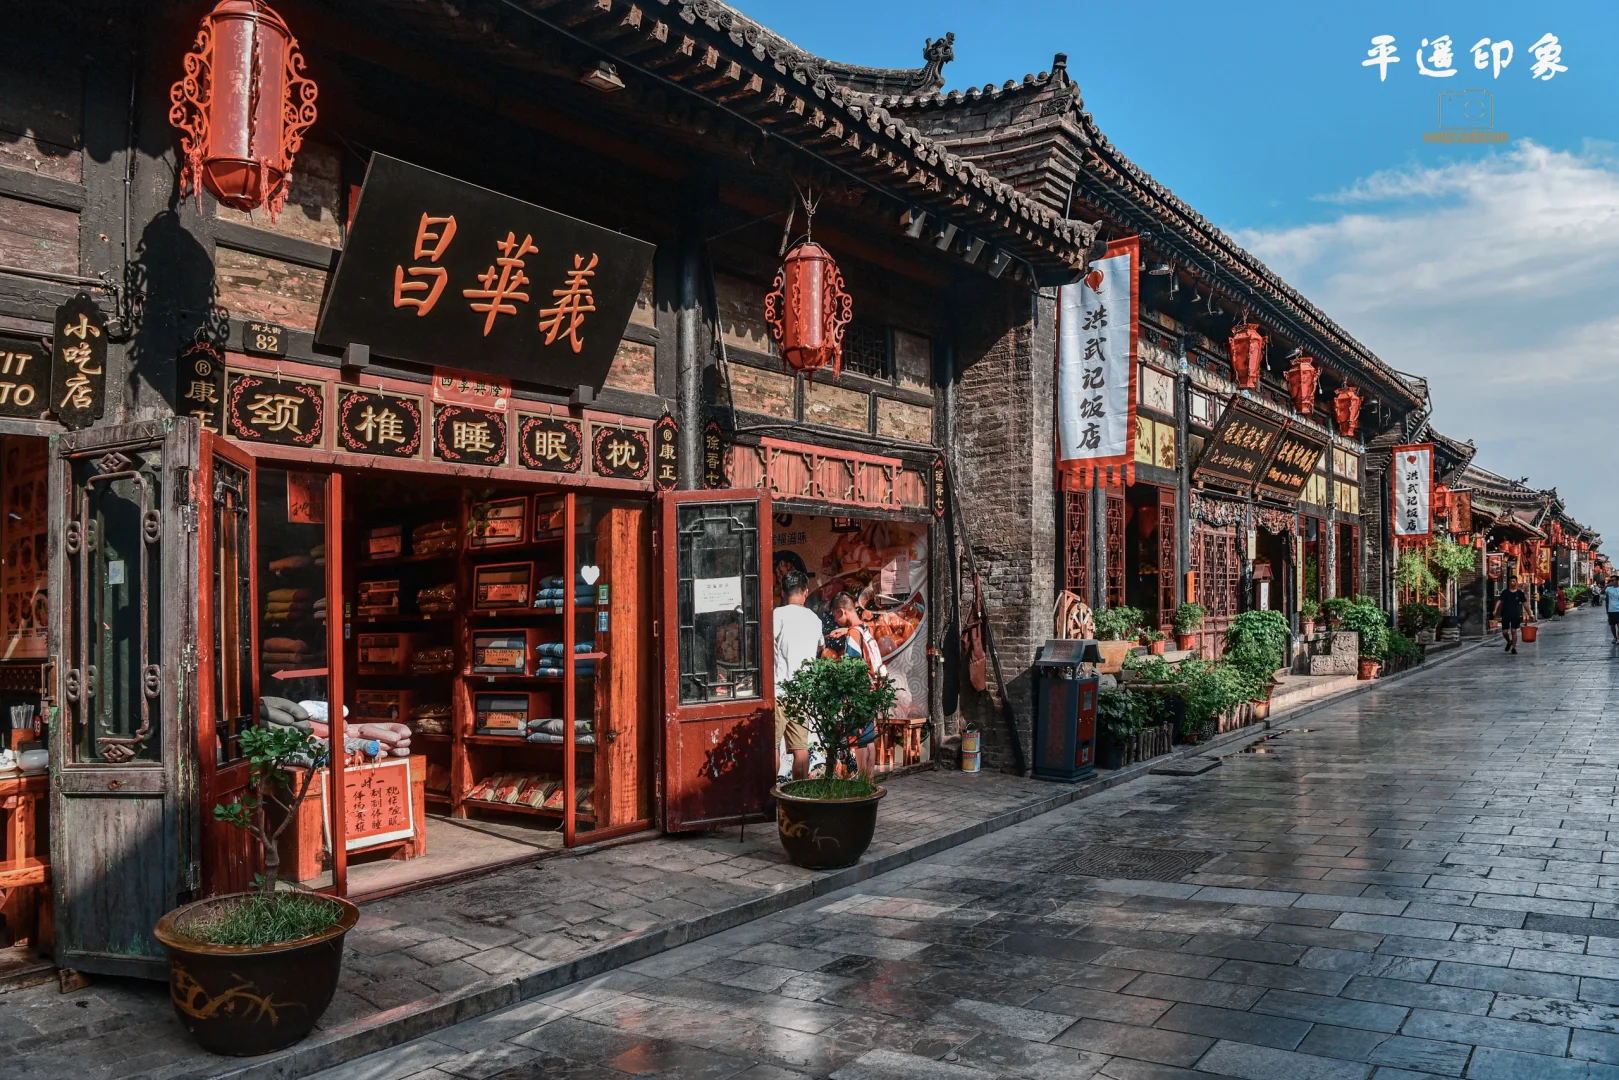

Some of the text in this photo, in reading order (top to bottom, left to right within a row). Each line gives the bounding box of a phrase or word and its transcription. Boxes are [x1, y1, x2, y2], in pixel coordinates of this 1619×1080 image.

[0, 350, 33, 376] IT
[60, 313, 102, 410] 小吃店
[255, 333, 278, 352] 82
[1076, 304, 1108, 451] 洪武记饭店
[1405, 470, 1419, 532] 洪武记饭店
[773, 531, 808, 546] 福滋味
